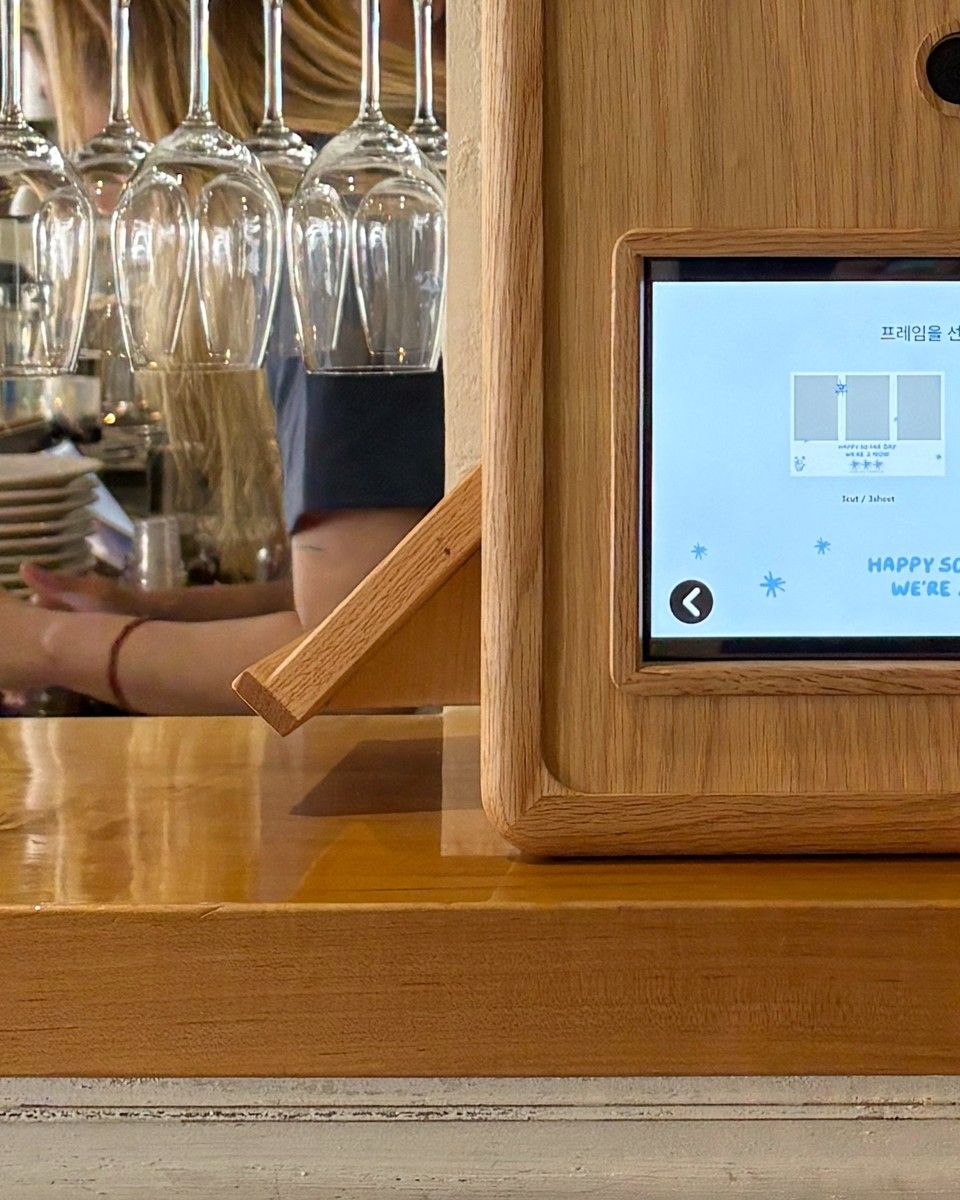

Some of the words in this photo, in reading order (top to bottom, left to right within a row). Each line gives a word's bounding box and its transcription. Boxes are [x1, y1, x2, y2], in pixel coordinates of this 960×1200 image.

[880, 324, 943, 342] 프레임을
[868, 556, 934, 574] HAPPY
[891, 580, 951, 597] WE'RE
